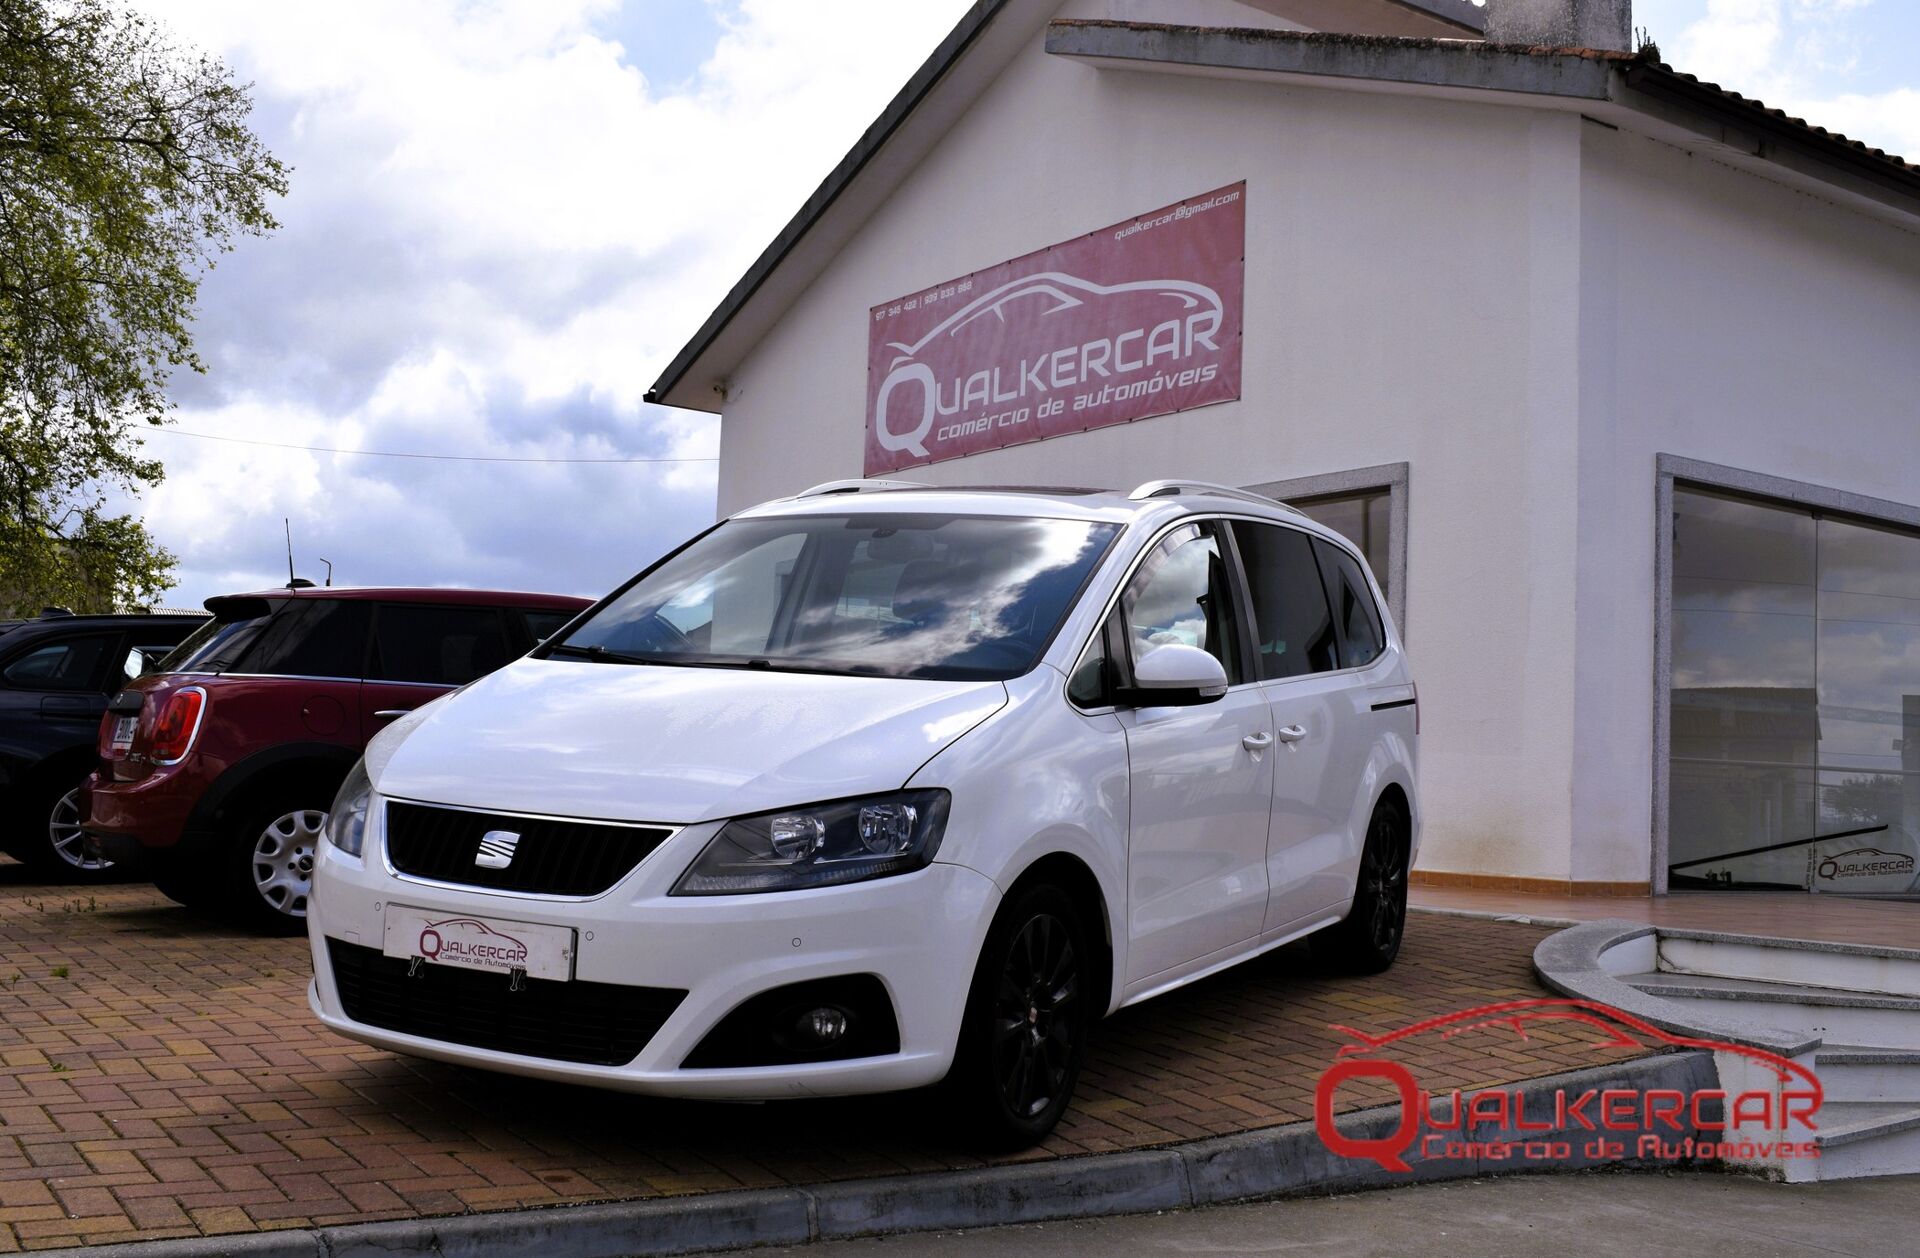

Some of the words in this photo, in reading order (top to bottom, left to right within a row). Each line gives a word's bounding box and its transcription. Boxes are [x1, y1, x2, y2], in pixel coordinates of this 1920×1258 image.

[1114, 191, 1240, 241] qualkercar@gmail.com
[876, 309, 1223, 456] QUALKERCAR
[937, 407, 1030, 441] comércio
[1037, 397, 1064, 418] de
[1073, 363, 1218, 411] automóveis
[1818, 860, 1914, 880] QUALKERCAR
[420, 929, 528, 962] QUALKERCAR
[474, 957, 483, 965] de
